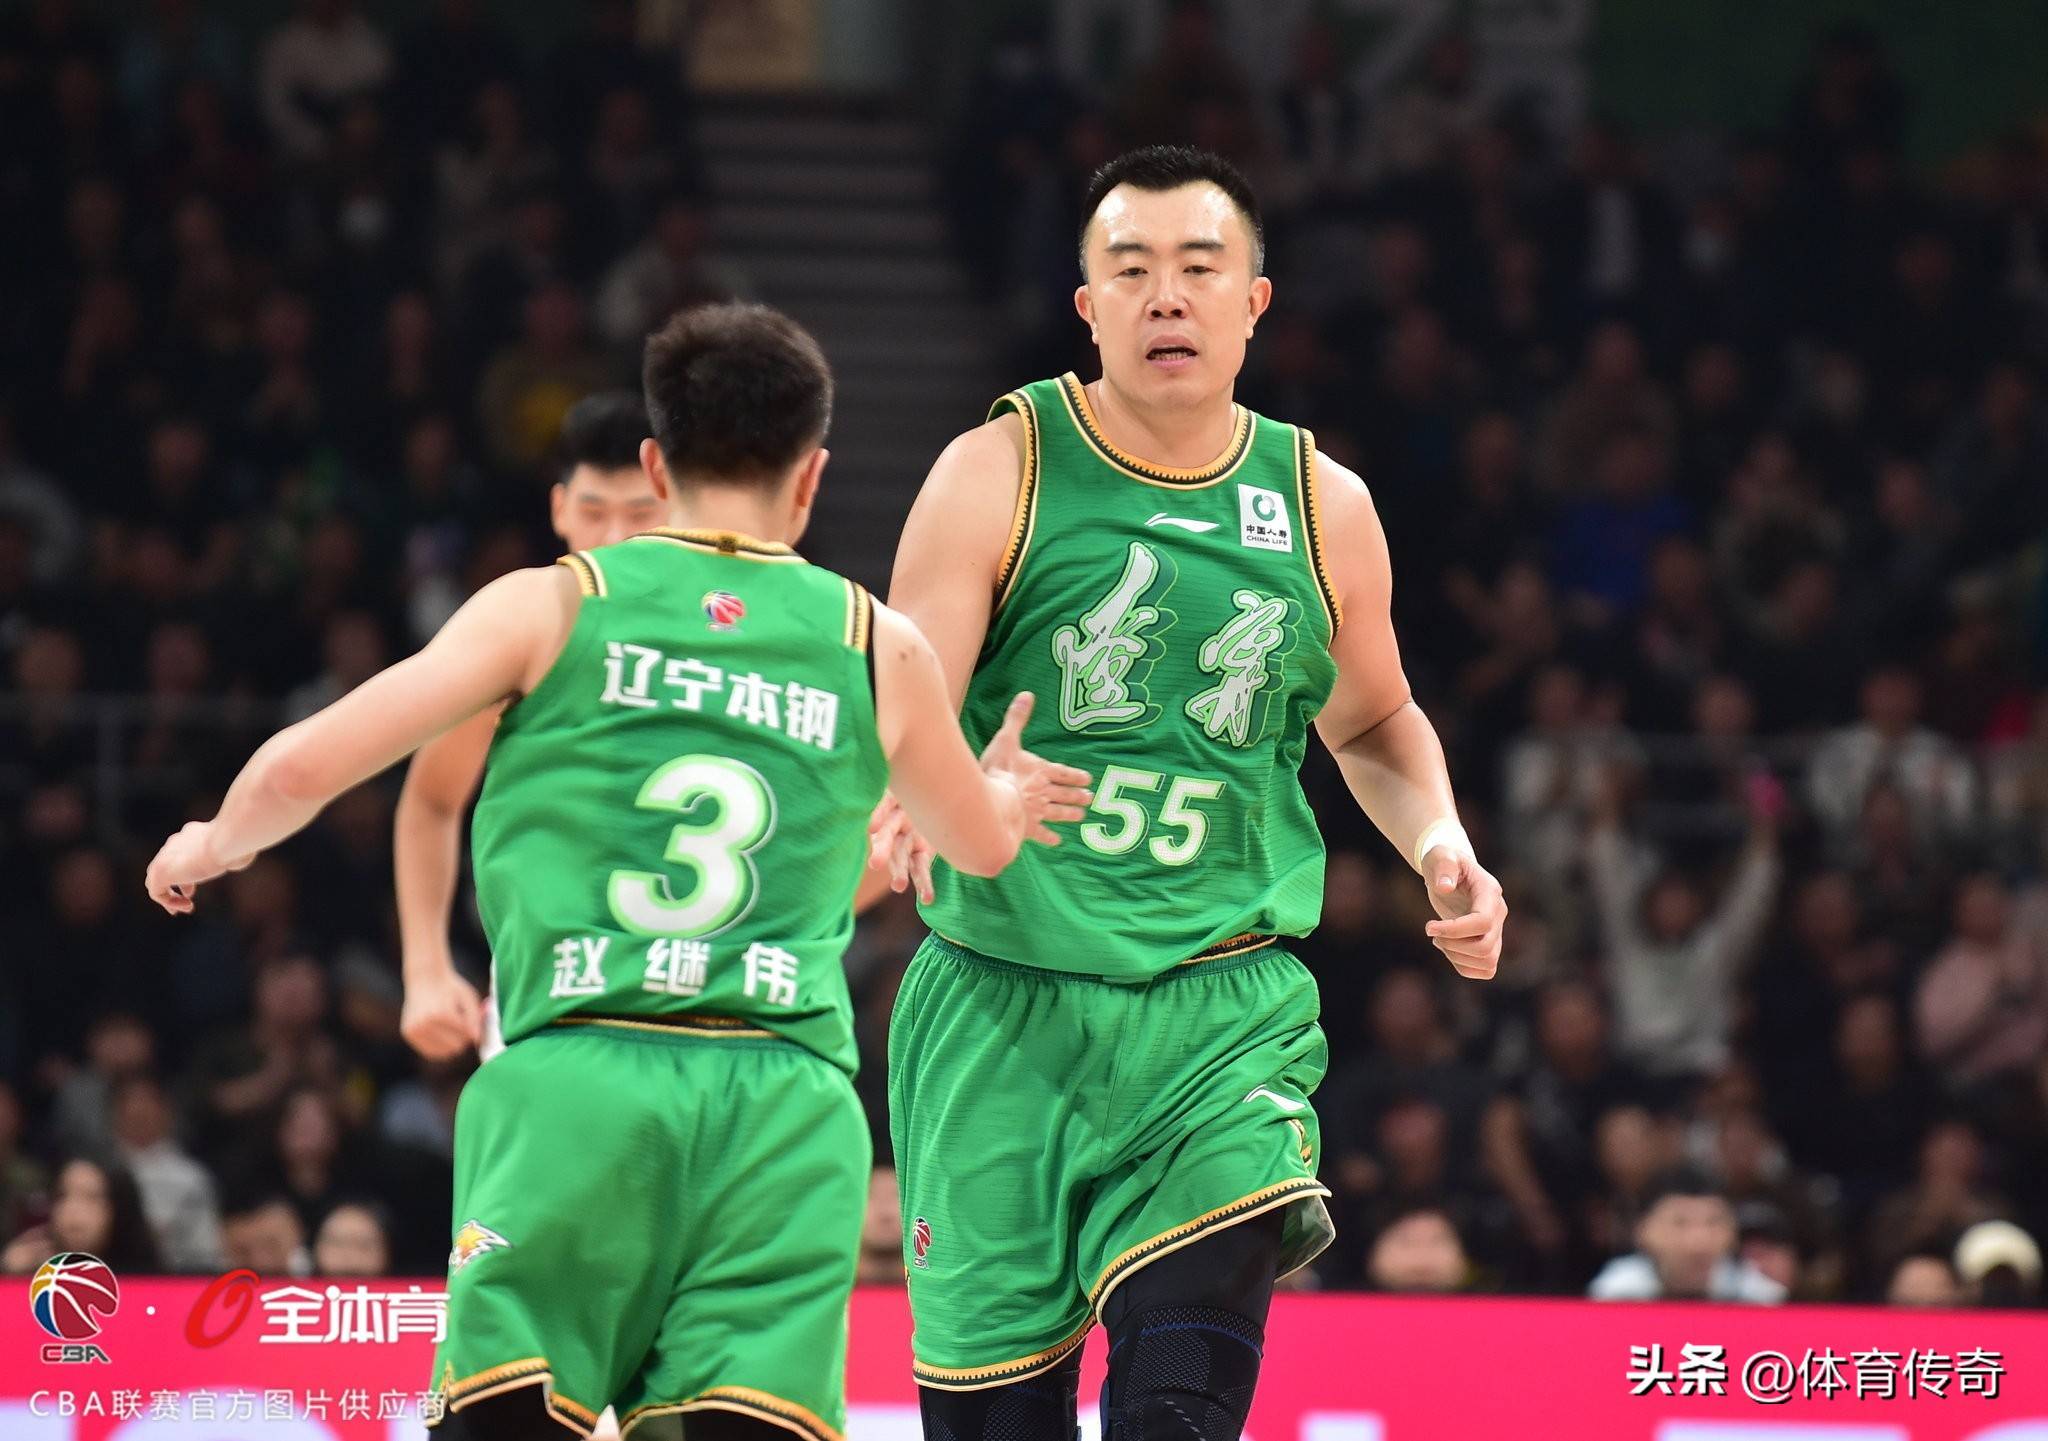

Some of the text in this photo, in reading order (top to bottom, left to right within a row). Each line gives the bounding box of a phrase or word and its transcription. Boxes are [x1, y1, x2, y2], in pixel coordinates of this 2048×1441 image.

[1246, 535, 1270, 544] CHINA
[599, 641, 839, 751] 辽宁本钢
[607, 754, 778, 940] 3
[1080, 764, 1226, 866] 55
[549, 936, 800, 1007] 赵继伟
